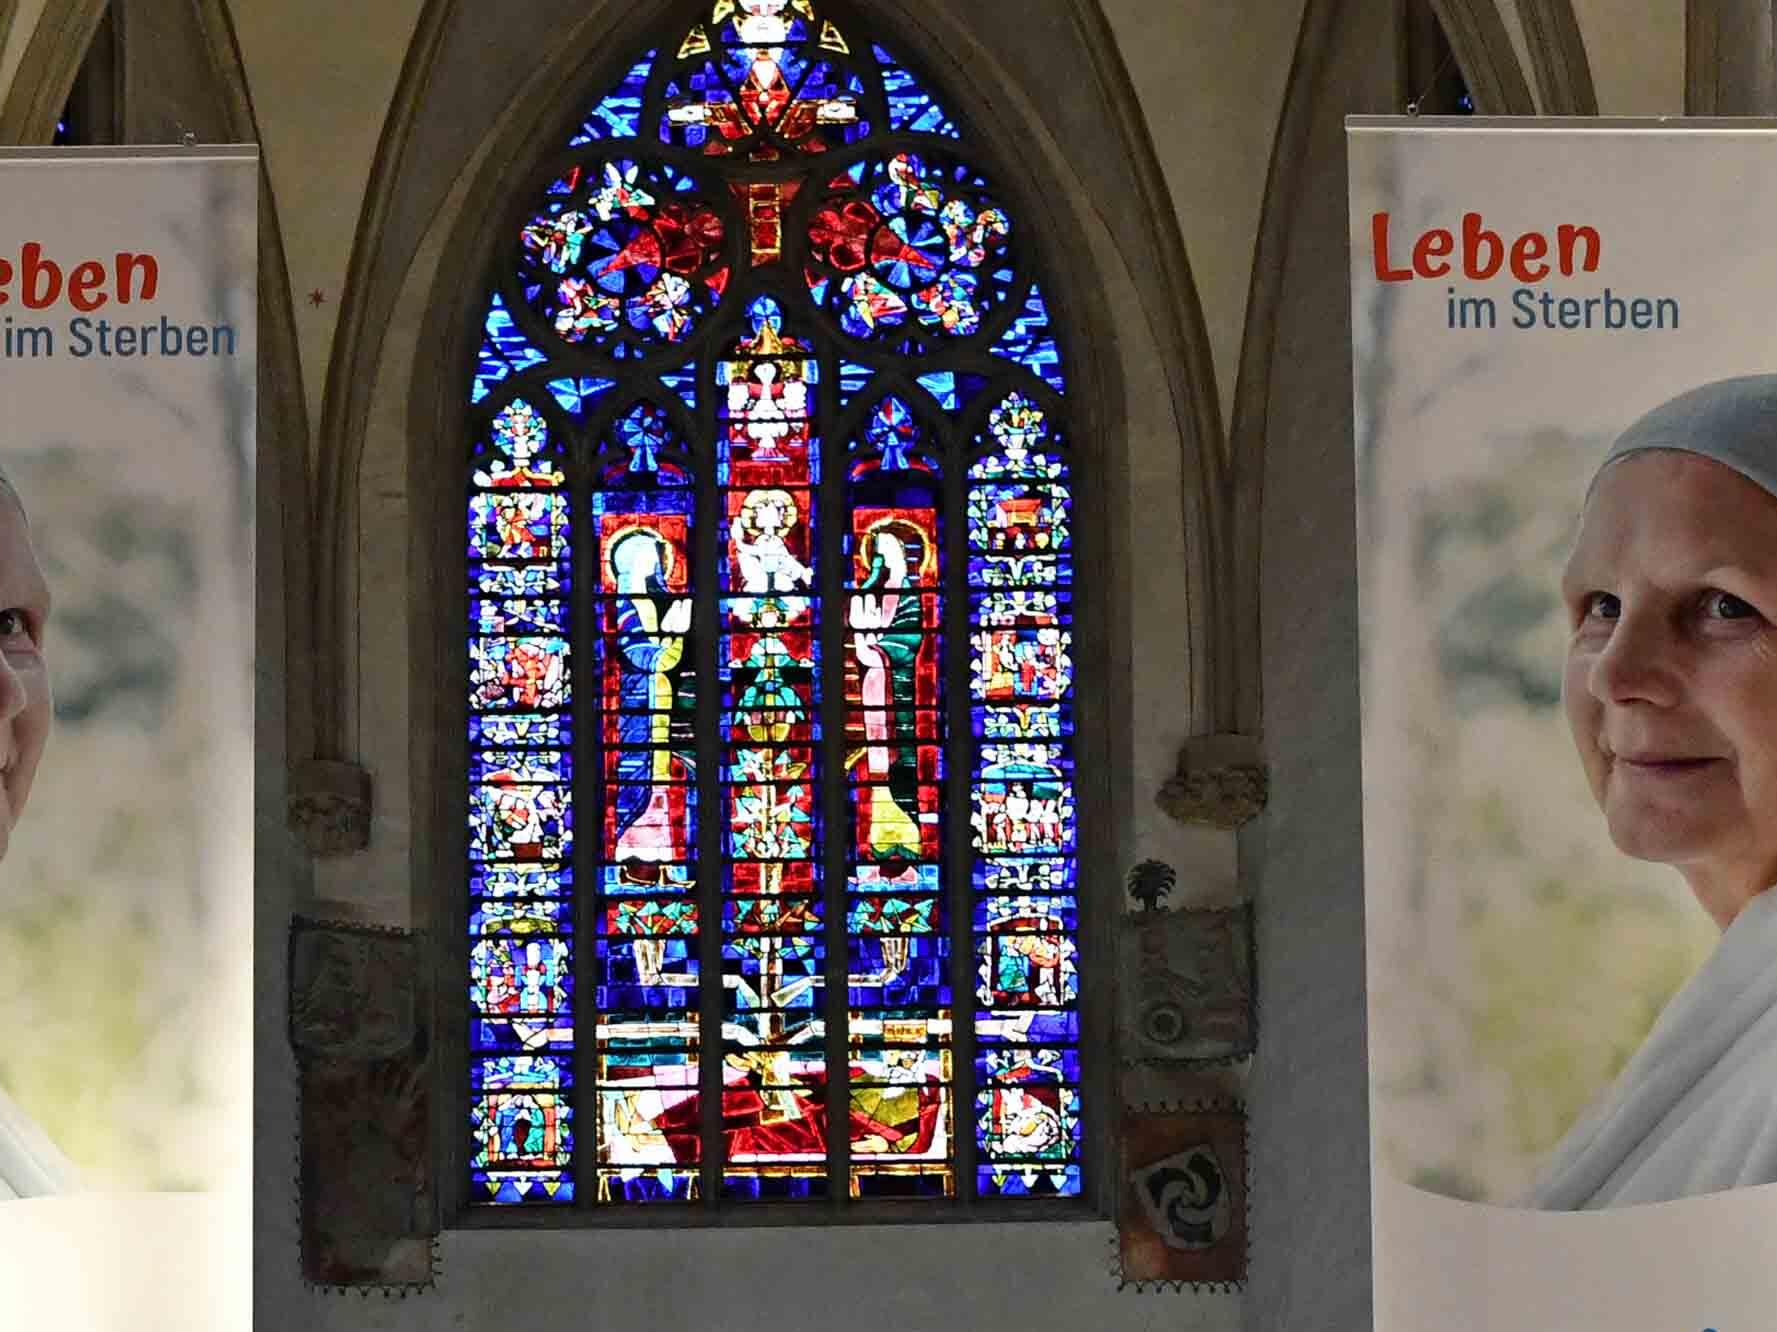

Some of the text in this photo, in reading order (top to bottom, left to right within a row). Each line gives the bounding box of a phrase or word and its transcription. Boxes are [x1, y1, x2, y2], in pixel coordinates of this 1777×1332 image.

[1373, 212, 1601, 283] Leben
[1447, 287, 1679, 330] im Sterben
[4, 317, 235, 358] im Sterben
